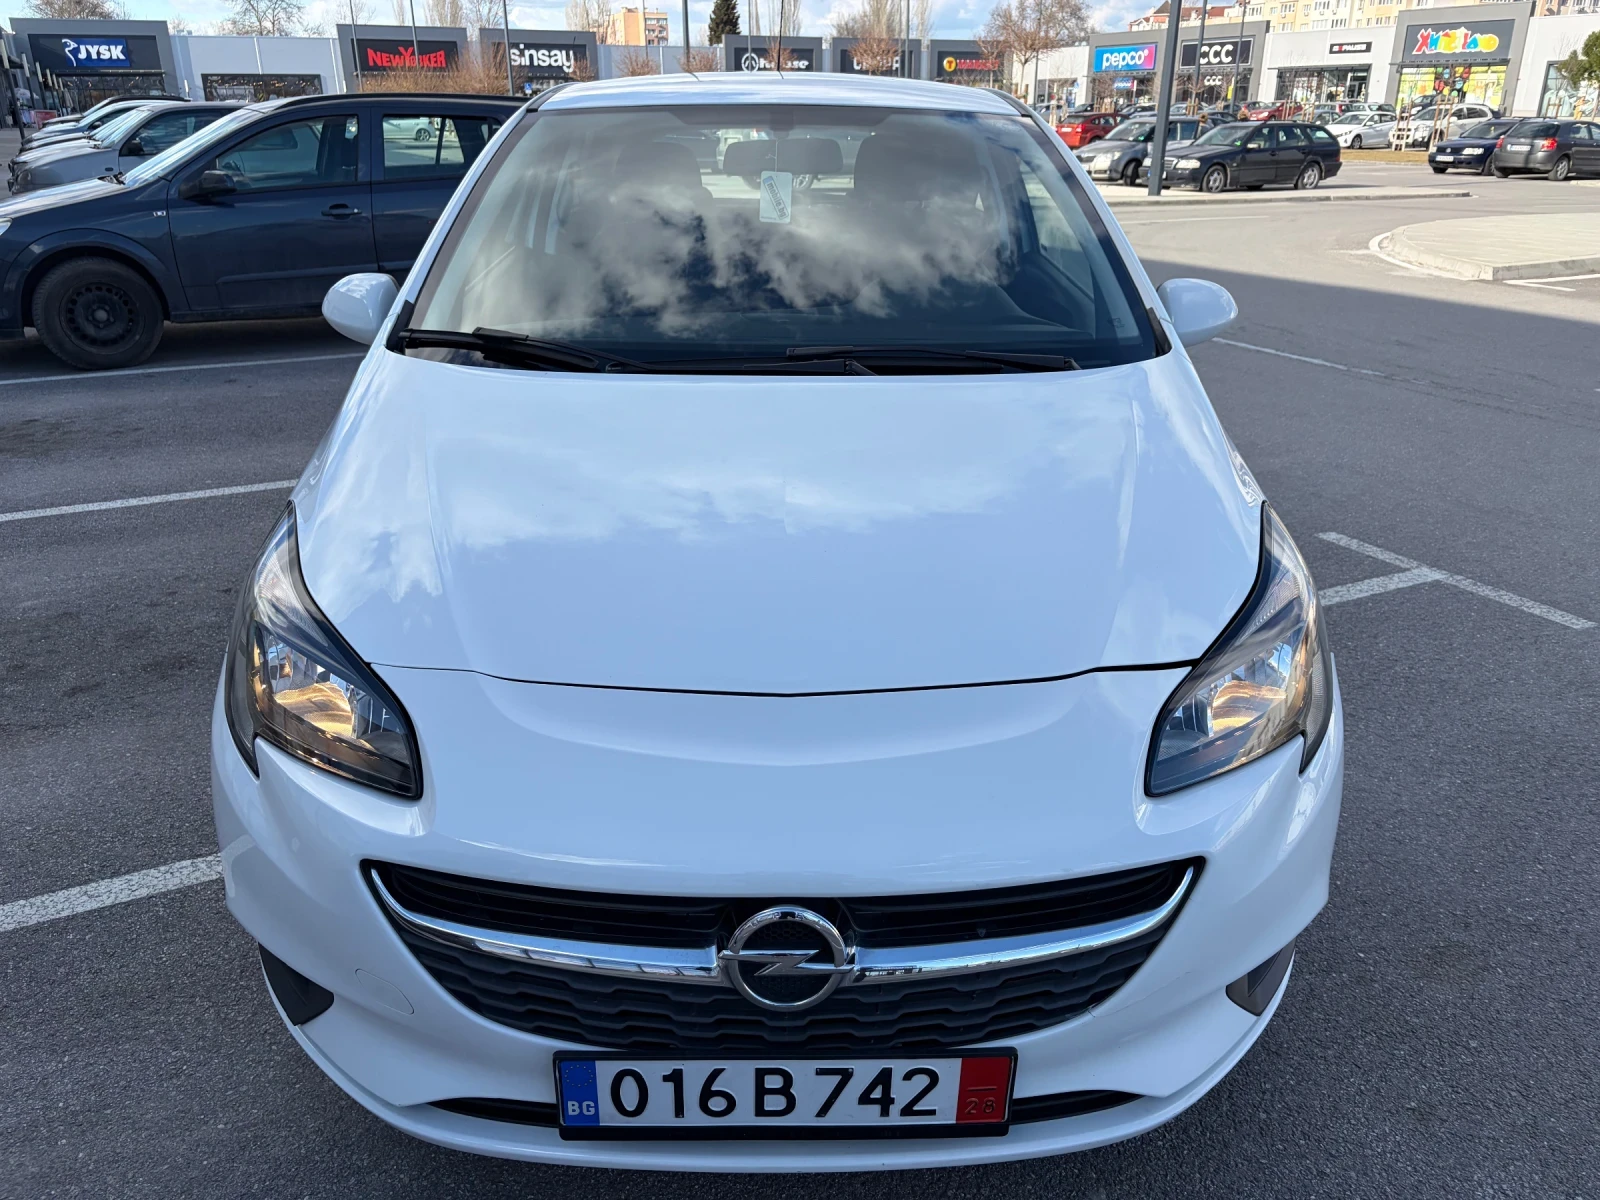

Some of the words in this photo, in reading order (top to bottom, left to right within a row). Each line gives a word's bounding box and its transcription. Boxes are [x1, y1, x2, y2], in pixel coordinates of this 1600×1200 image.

[78, 44, 126, 60] JYSK
[509, 43, 574, 73] sinsay
[1102, 50, 1145, 70] pepco
[766, 181, 787, 218] mobile.bg
[567, 1100, 596, 1116] BG
[964, 1097, 996, 1115] 28
